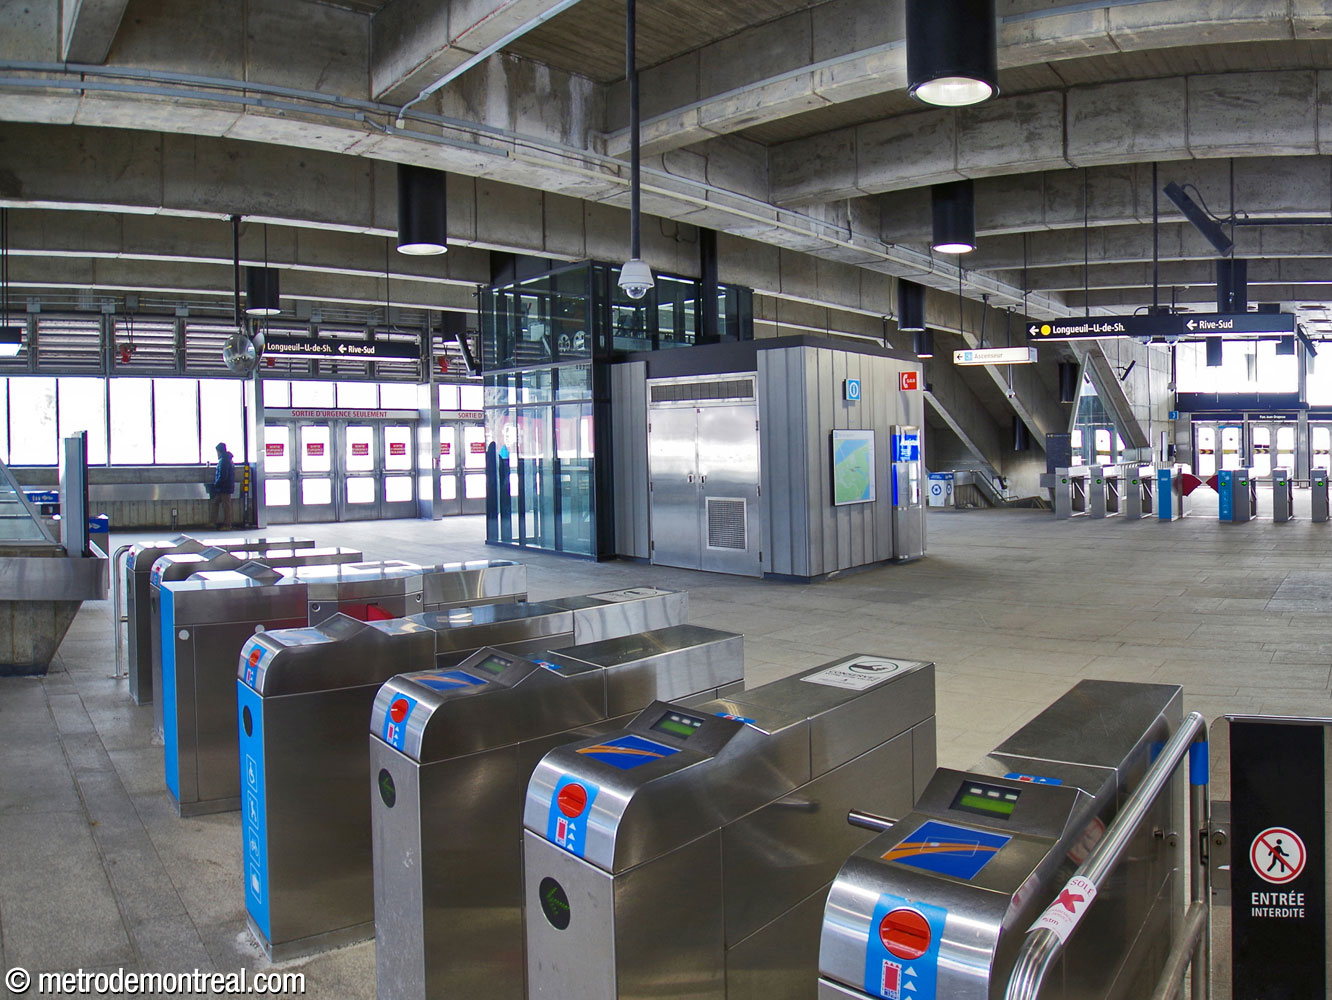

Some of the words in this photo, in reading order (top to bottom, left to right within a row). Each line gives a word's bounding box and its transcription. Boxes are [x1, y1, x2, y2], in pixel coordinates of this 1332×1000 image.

[1199, 319, 1233, 329] Rive-Sud
[348, 345, 375, 354] Rive-Sud
[974, 352, 1003, 360] Ascenseur
[316, 410, 351, 418] D'URGENCE
[1251, 890, 1305, 906] ENTRÉE
[1251, 907, 1305, 918] INTERDITE
